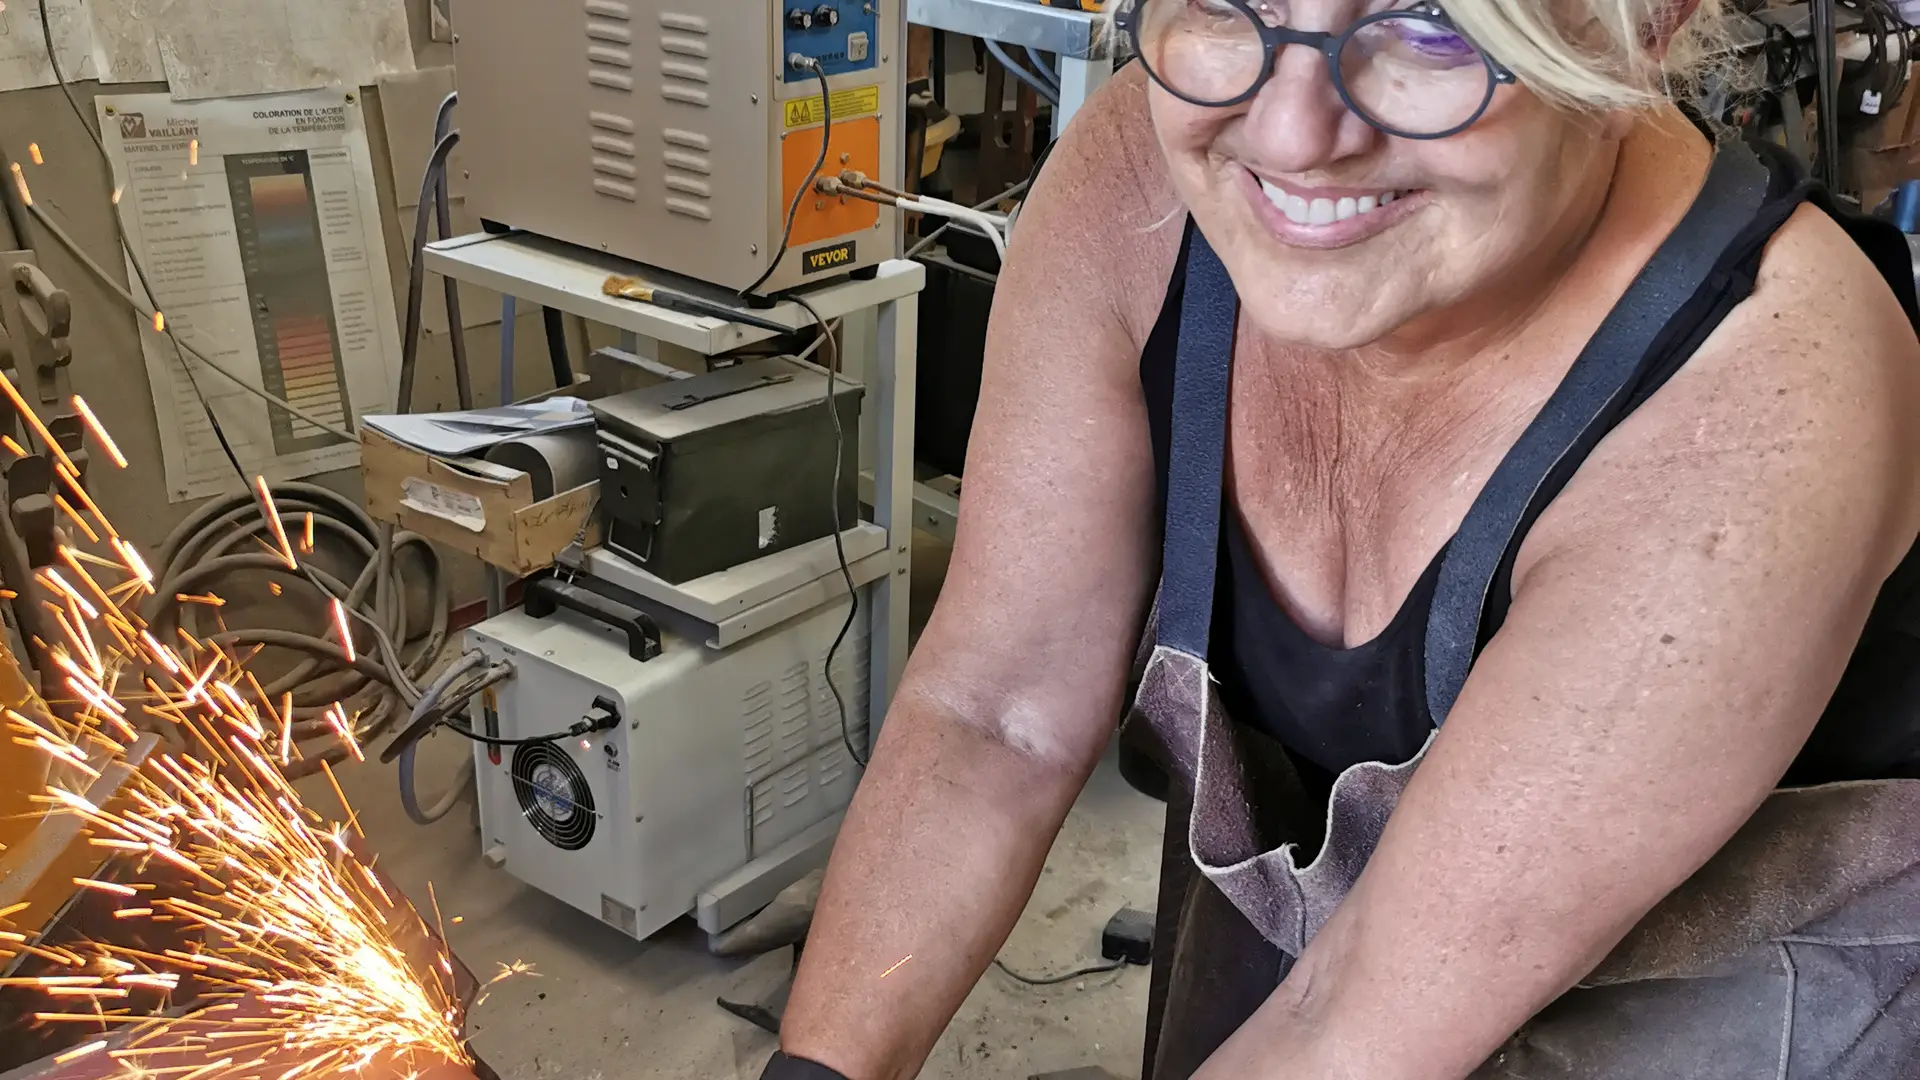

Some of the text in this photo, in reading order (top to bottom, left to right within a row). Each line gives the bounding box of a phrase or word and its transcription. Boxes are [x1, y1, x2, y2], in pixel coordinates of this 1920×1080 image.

[253, 106, 344, 120] COLORATION DE L'ACIER
[167, 118, 199, 127] Michel
[295, 115, 346, 125] EN FONCTION
[148, 127, 199, 138] VAILLANT
[268, 126, 279, 136] DE
[281, 126, 291, 135] LA
[810, 247, 848, 267] VEVOR
